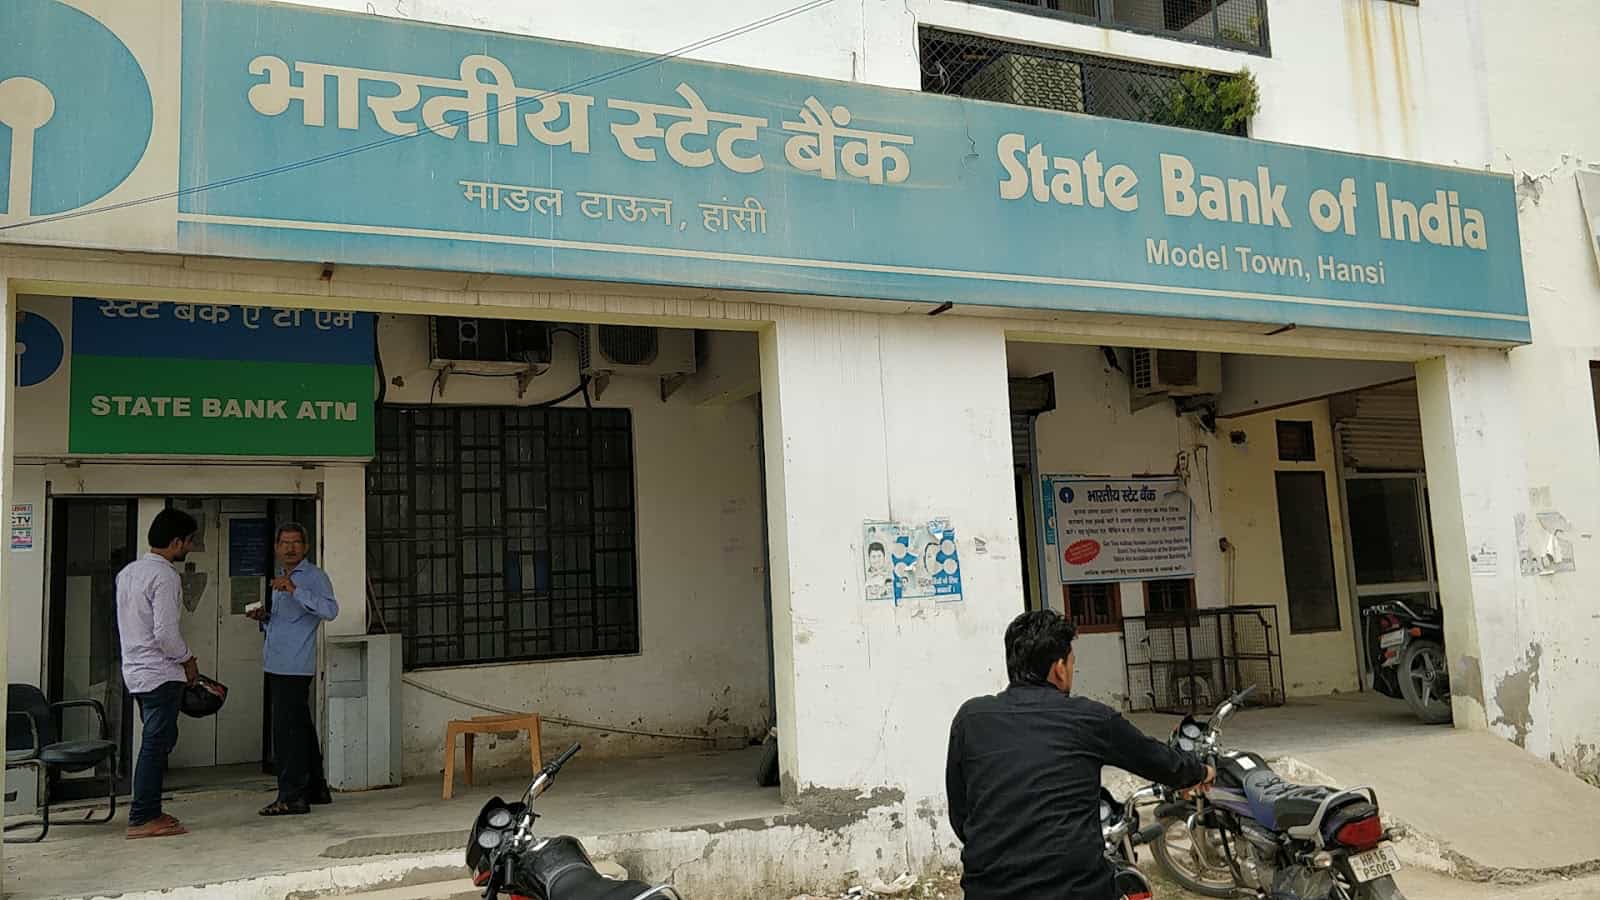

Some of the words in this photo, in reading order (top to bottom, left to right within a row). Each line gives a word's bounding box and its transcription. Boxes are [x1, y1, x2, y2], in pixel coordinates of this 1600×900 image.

[248, 54, 594, 154] भारतीय
[607, 82, 769, 174] स्टेट
[782, 95, 914, 185] बैंक
[458, 180, 564, 217] माडल
[698, 196, 768, 234] हांसी
[997, 132, 1139, 212] State
[1160, 152, 1292, 229] Bank
[1309, 177, 1357, 236] of
[1375, 181, 1488, 251] India
[1145, 238, 1229, 271] Model
[1235, 246, 1311, 283] Town,
[1317, 254, 1385, 285] Hansi
[90, 394, 192, 418] STATE
[202, 397, 288, 420] BANK
[296, 400, 358, 421] ATM
[1087, 484, 1120, 503] भारतीय
